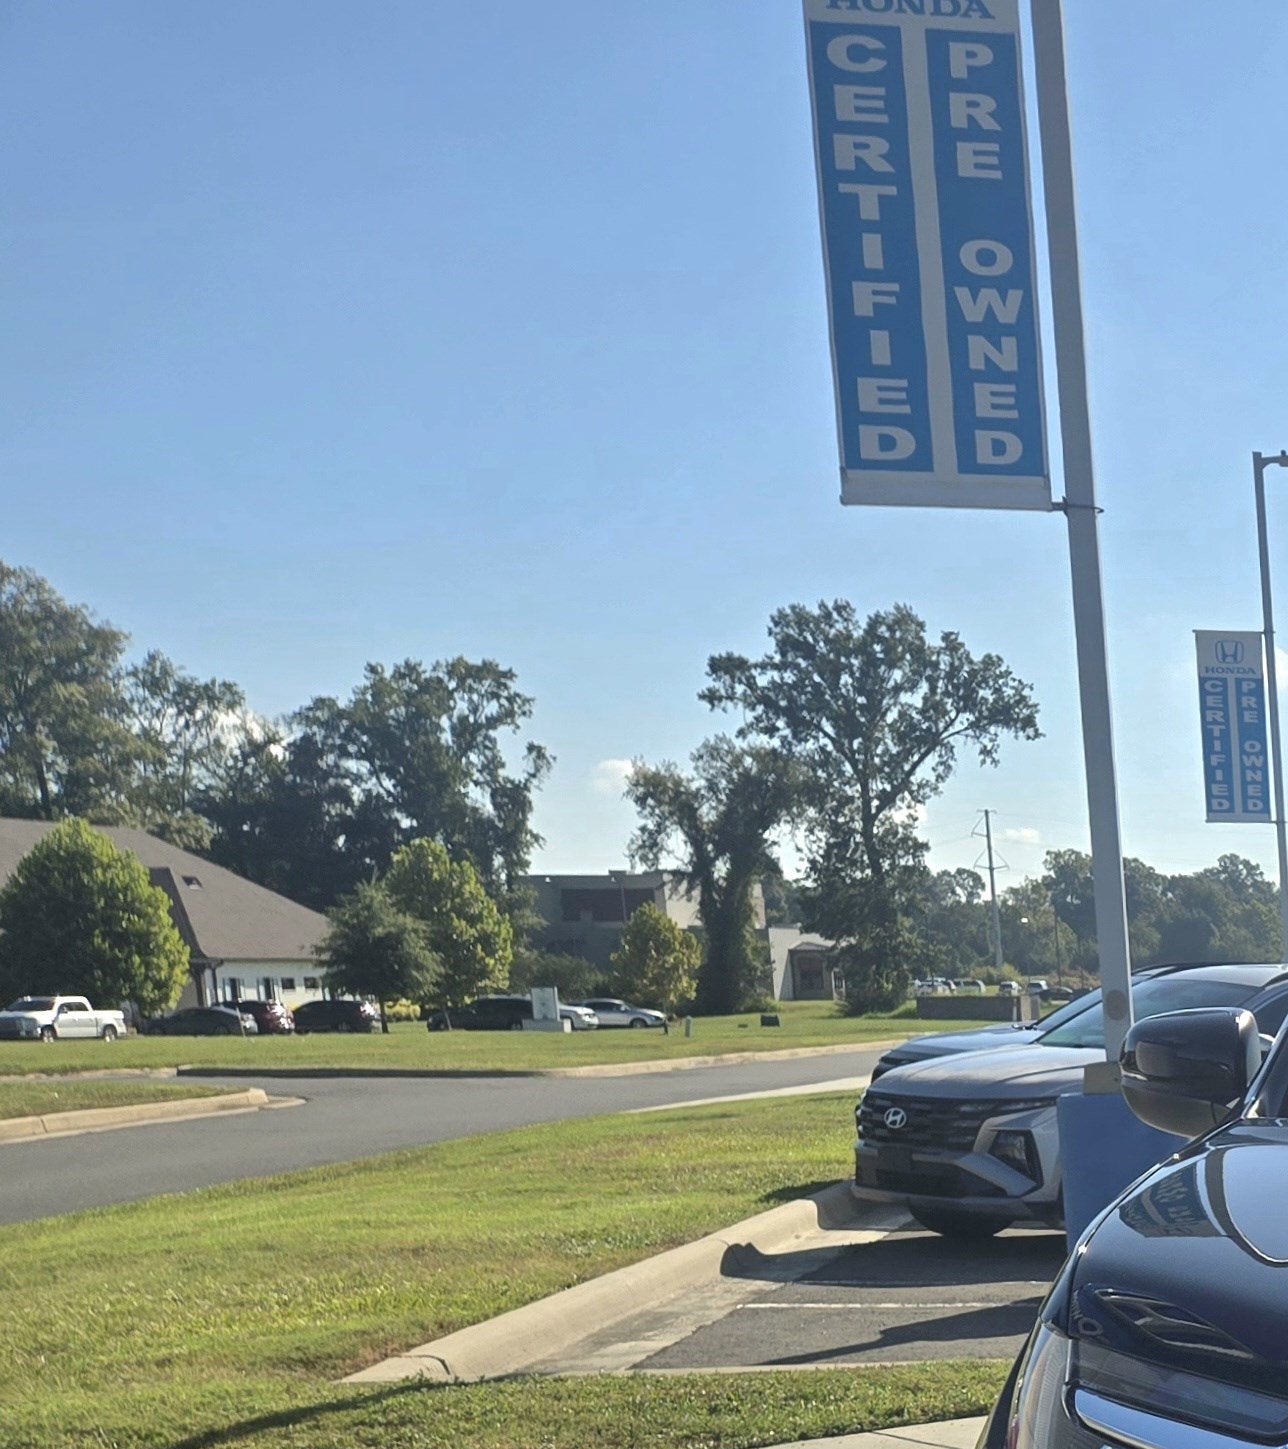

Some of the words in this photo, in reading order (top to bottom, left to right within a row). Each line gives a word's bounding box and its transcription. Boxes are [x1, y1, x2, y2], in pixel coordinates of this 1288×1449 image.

[948, 41, 1003, 180] PRE
[826, 34, 917, 461] CERTIFIED
[953, 239, 1024, 466] OWNED
[1204, 666, 1257, 675] HONDA
[1241, 681, 1259, 723] PRE
[1203, 680, 1231, 811] CERTIFIED
[1241, 740, 1264, 811] OWNED
